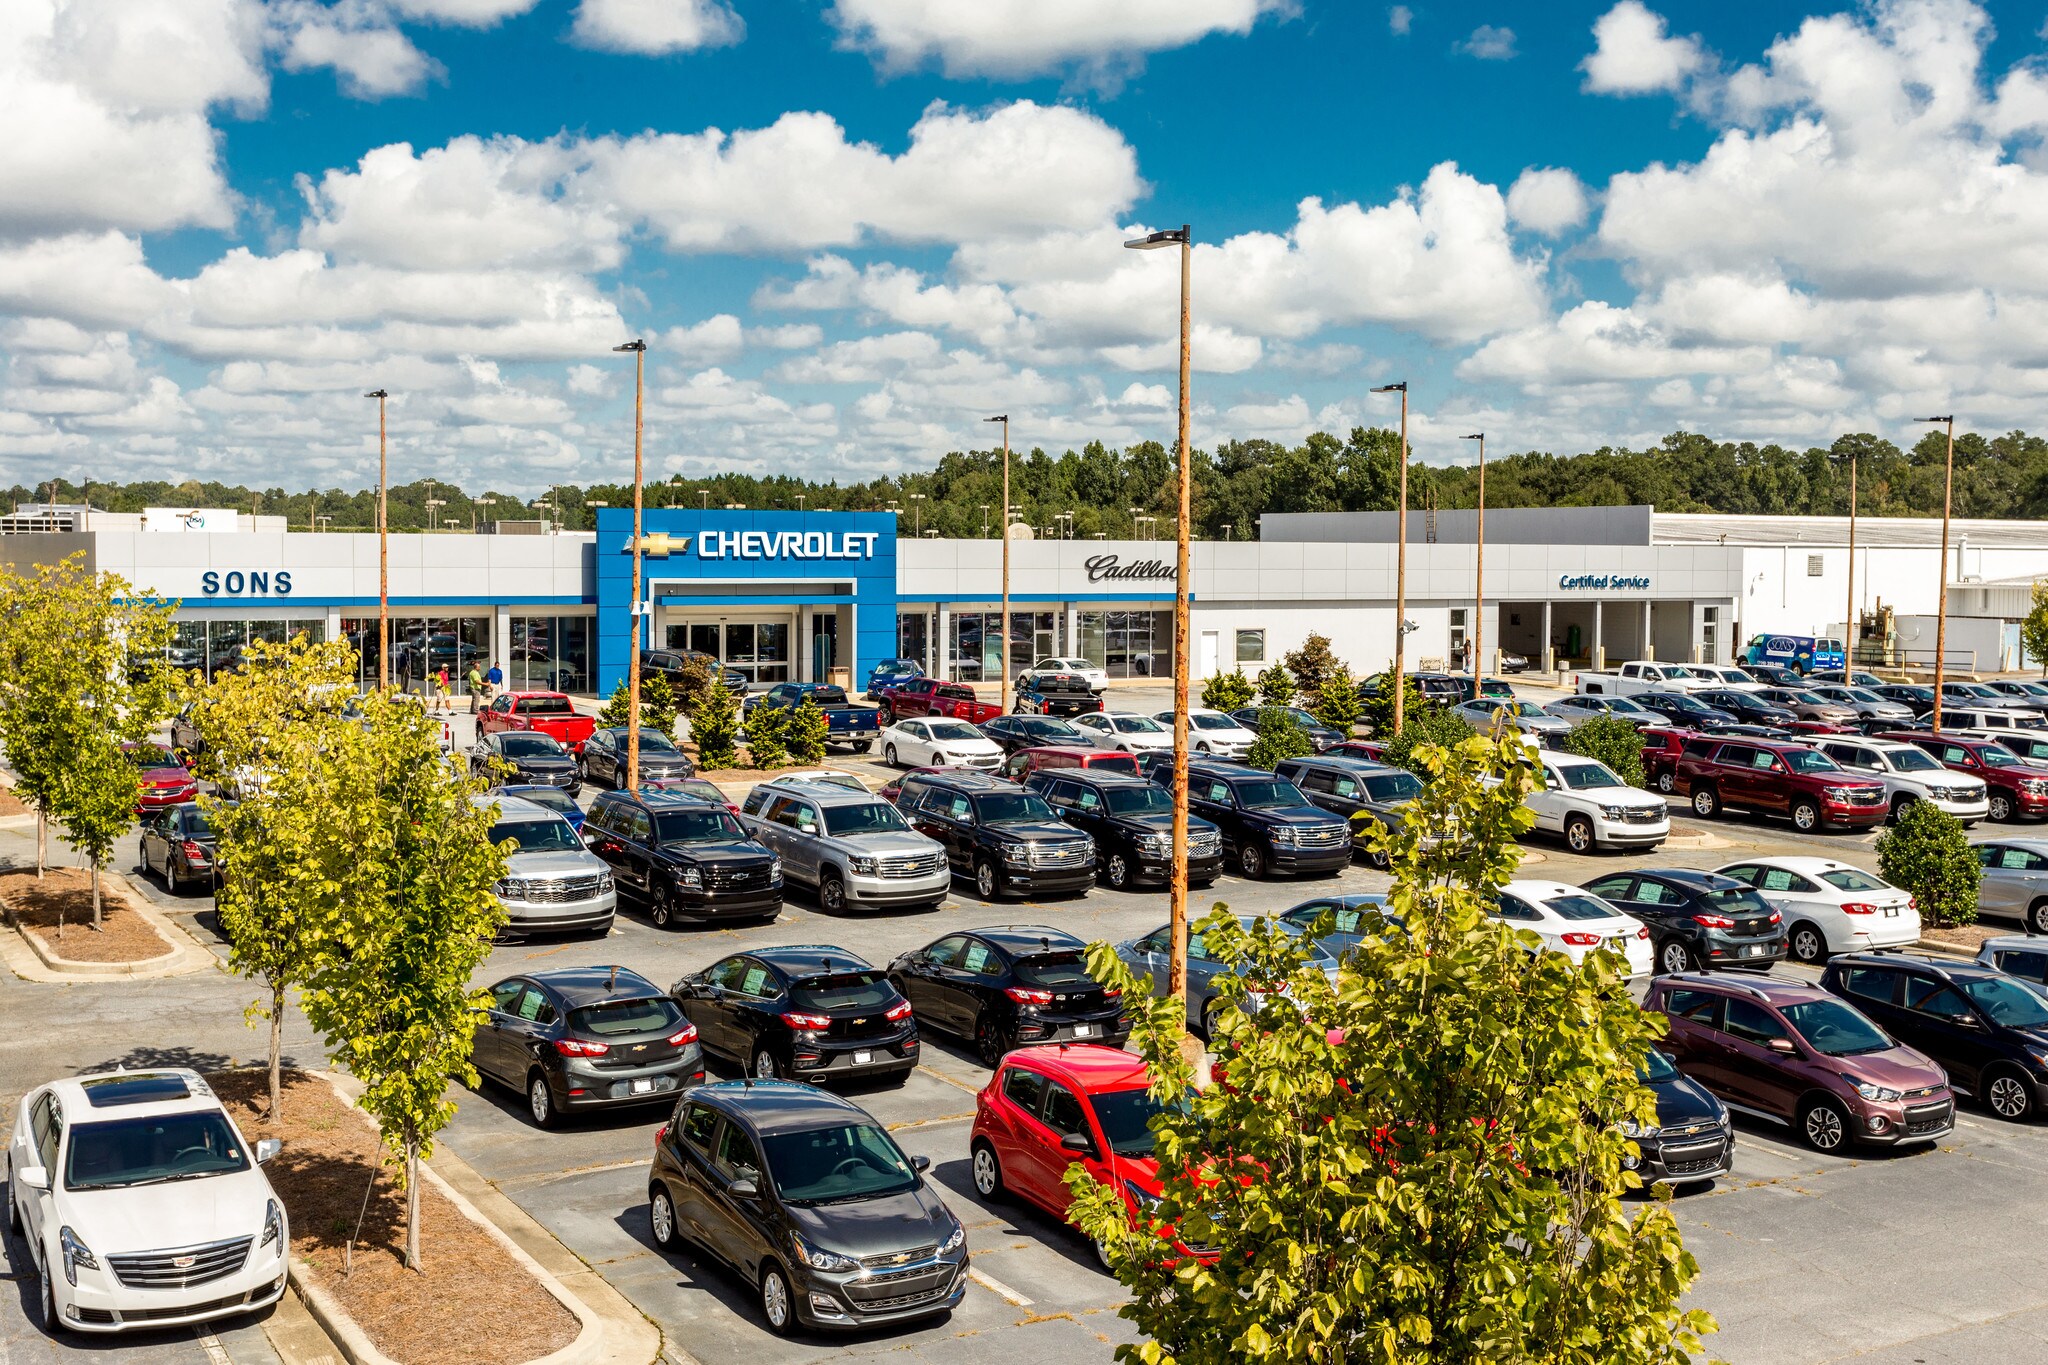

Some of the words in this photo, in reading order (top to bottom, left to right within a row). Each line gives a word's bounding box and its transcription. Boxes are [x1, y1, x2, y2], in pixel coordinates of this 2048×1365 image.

[698, 531, 879, 558] CHEVROLET
[202, 571, 292, 594] SONS
[1560, 575, 1608, 588] Certified
[1611, 575, 1650, 588] Service
[1770, 639, 1793, 651] SONS
